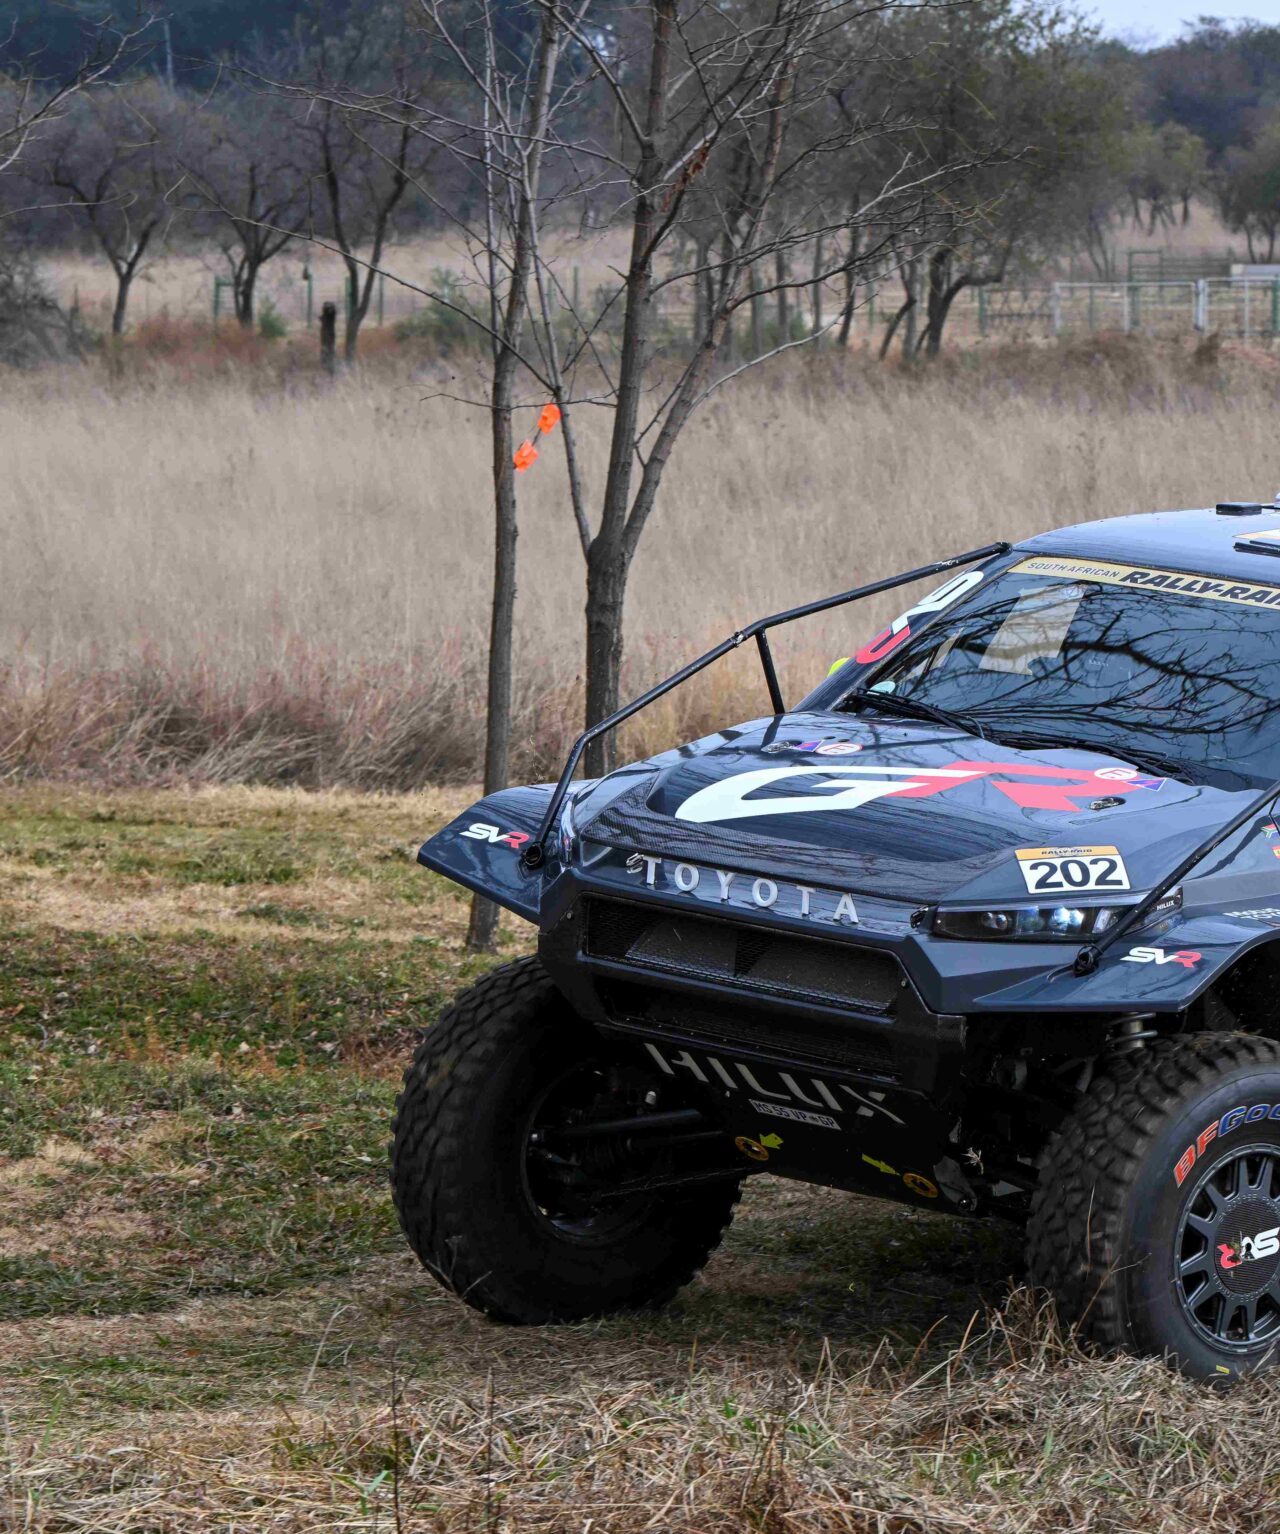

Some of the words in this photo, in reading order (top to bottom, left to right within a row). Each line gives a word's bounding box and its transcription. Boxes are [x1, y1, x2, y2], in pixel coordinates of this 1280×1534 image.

[1027, 562, 1070, 572] SOUTH
[1068, 566, 1120, 578] AFRICAN
[675, 760, 1141, 823] GR
[459, 822, 529, 849] SVR
[1029, 857, 1123, 889] 202
[640, 854, 860, 924] TOYOTA
[1156, 900, 1175, 911] HILUX
[1120, 946, 1202, 968] SVR
[644, 1043, 906, 1125] HILUX
[772, 1106, 791, 1117] 55
[790, 1109, 807, 1121] VP
[818, 1116, 836, 1127] GP
